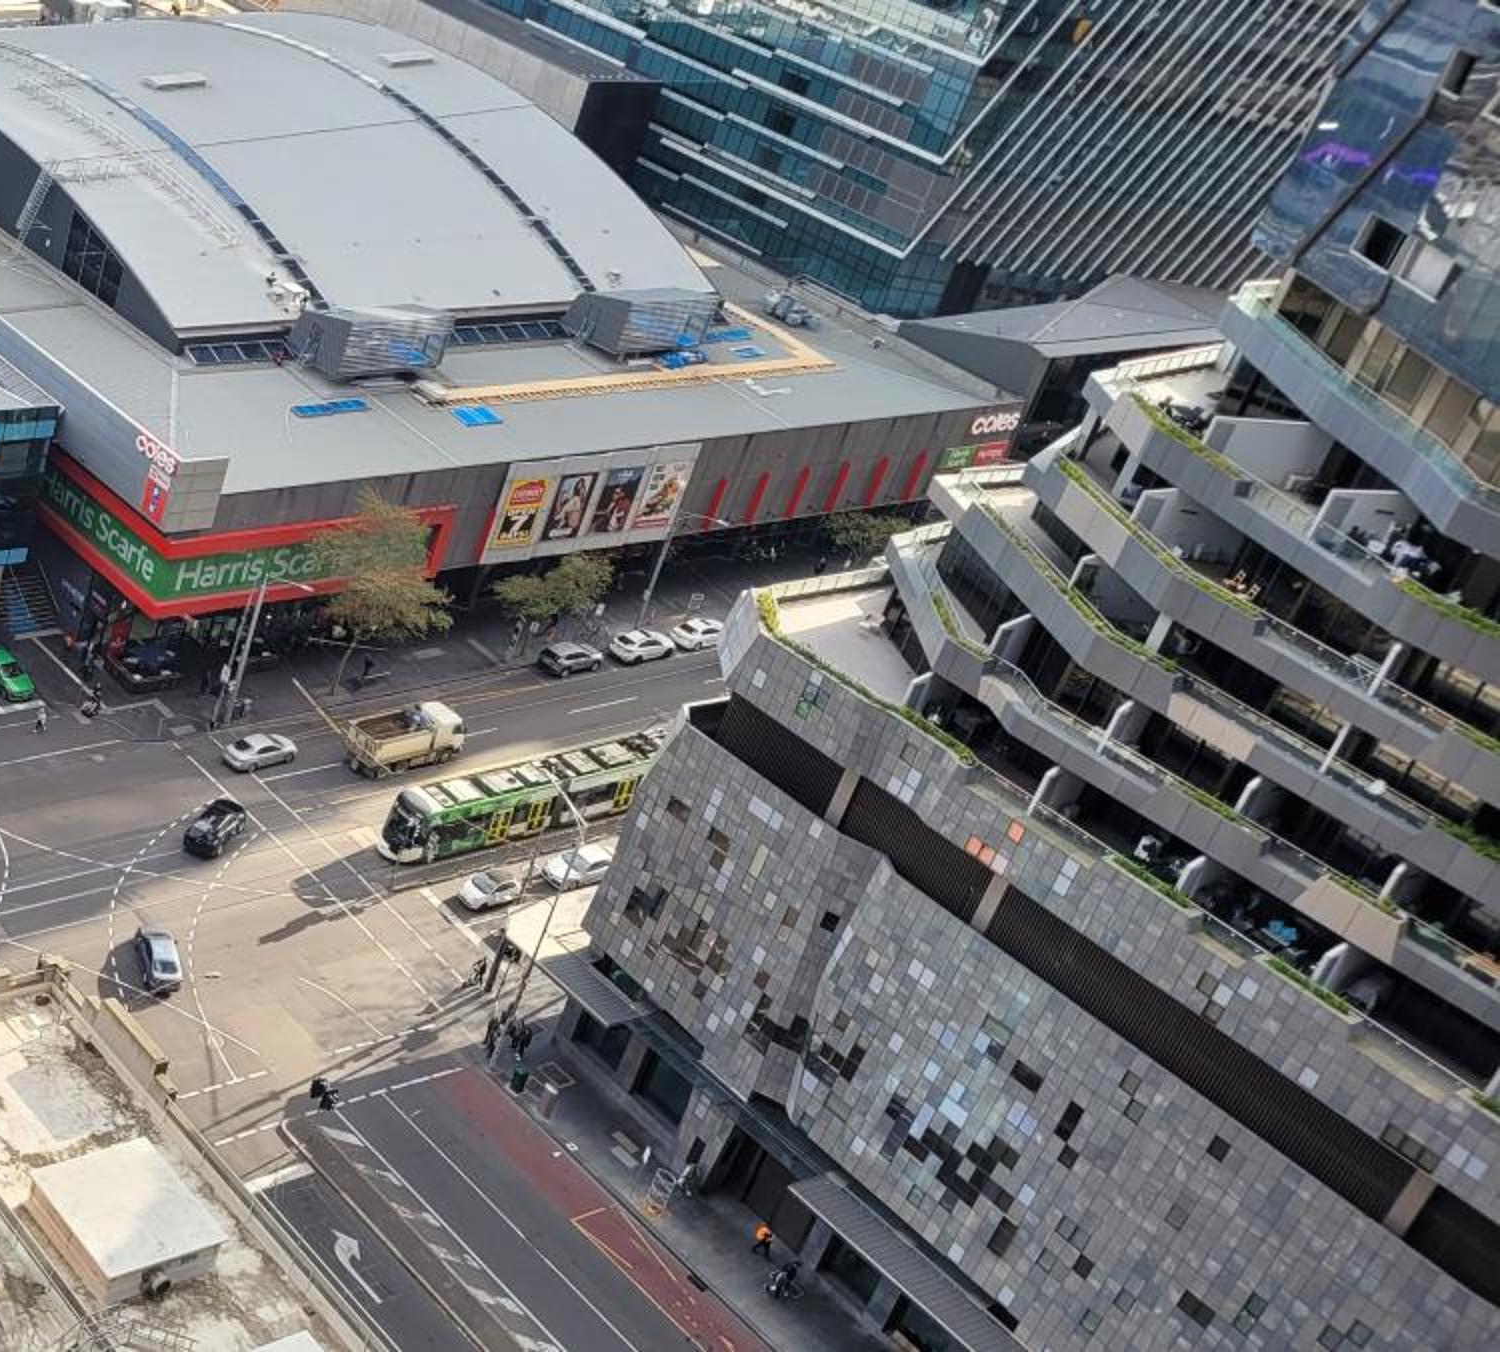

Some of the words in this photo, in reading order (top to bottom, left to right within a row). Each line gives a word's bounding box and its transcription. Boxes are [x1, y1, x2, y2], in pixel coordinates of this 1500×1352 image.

[971, 411, 1020, 435] coles
[135, 434, 176, 475] coles
[508, 514, 529, 535] 7
[95, 512, 155, 582] Scarfe
[174, 553, 265, 591] Harris
